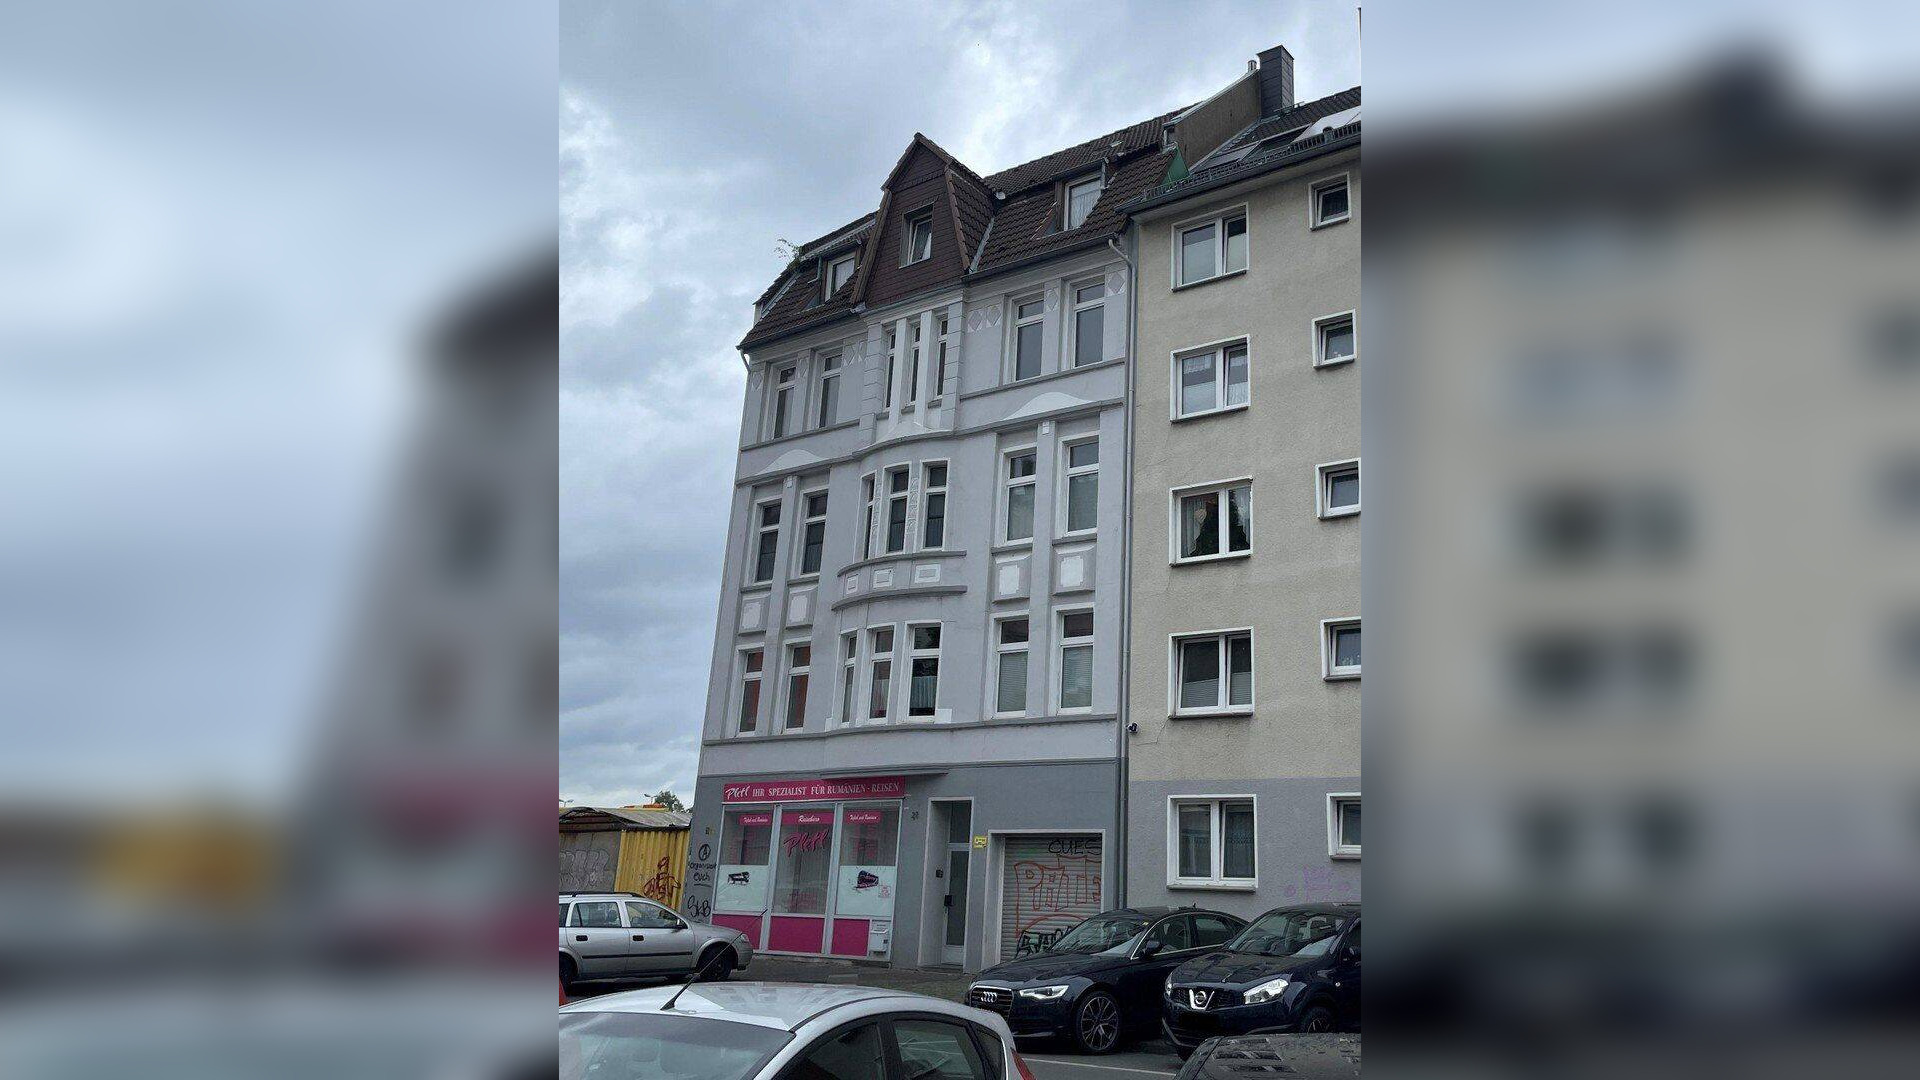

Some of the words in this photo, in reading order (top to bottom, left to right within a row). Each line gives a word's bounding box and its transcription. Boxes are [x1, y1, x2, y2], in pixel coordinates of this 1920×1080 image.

[752, 788, 766, 797] IHR
[768, 786, 807, 797] SPEZIALIST
[810, 784, 826, 795] FÜR
[871, 782, 900, 793] REISEN
